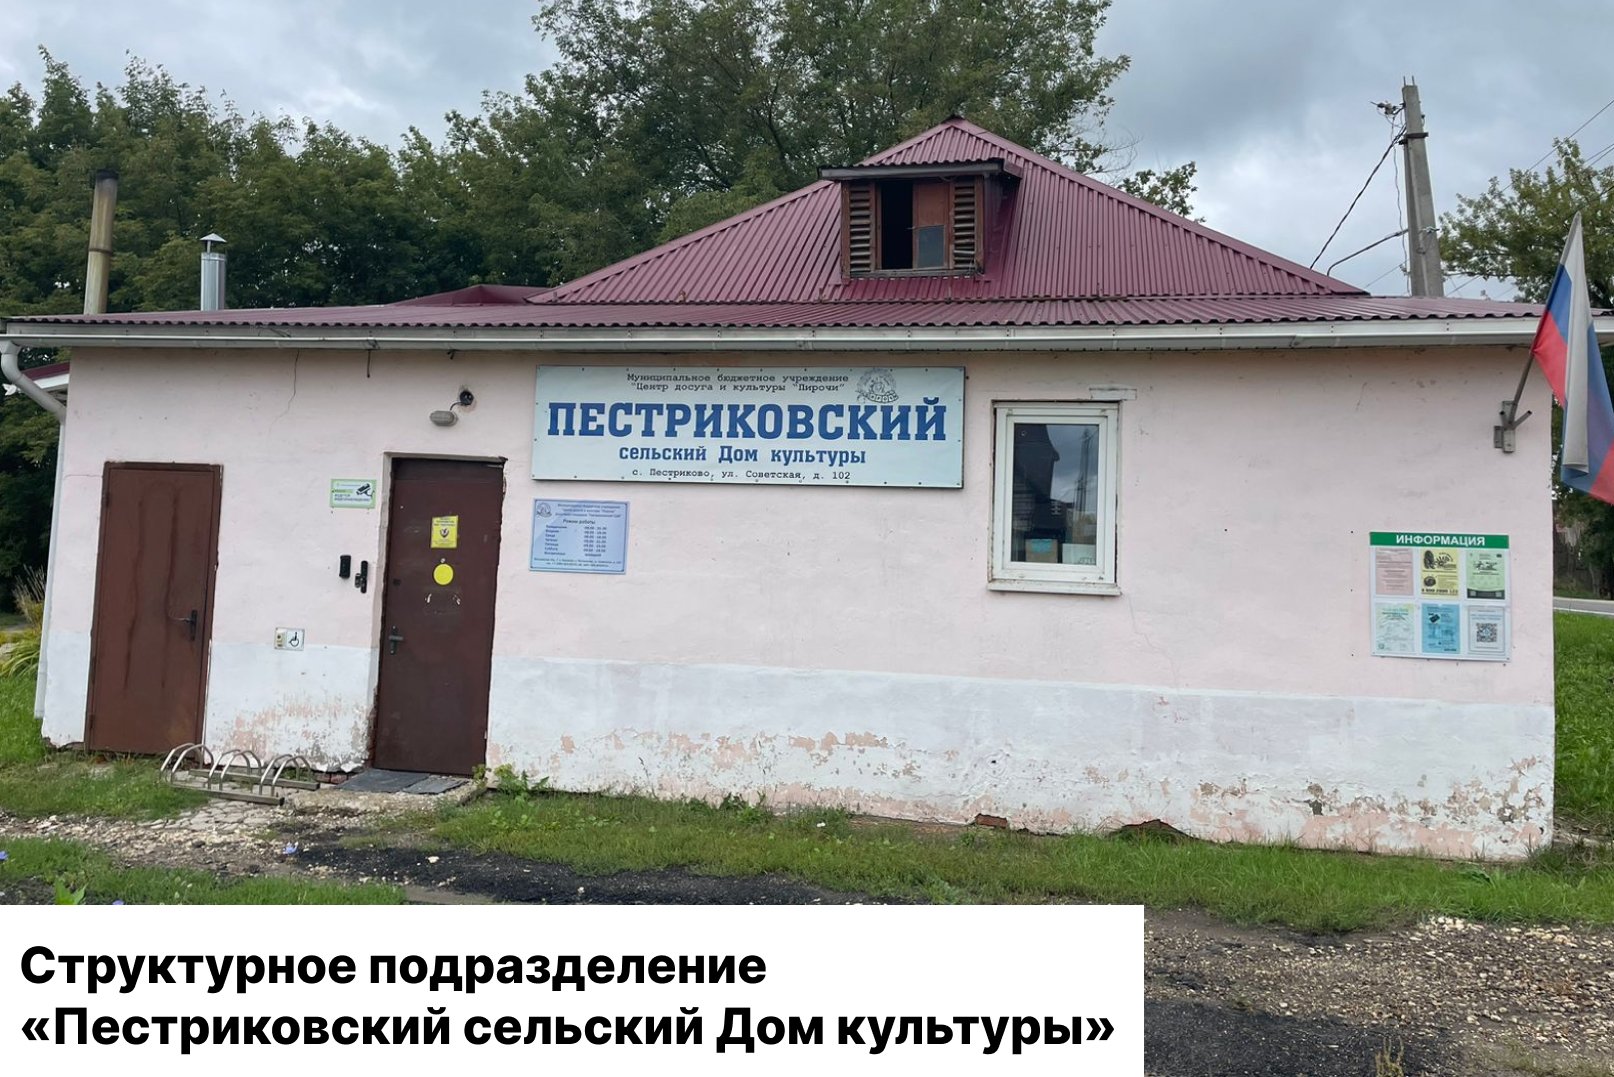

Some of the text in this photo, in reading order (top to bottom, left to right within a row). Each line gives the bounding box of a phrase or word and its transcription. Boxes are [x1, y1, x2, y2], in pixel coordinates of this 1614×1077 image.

[627, 373, 849, 384] Муниципальное бюджетное учреждение
[733, 384, 786, 393] культуры
[548, 397, 947, 441] ПЕСТРИКОВСКИЙ
[620, 445, 866, 467] сельский Дом культуры
[649, 468, 714, 479] Пестриково,
[745, 470, 806, 480] Советская,
[812, 472, 824, 480] д.
[832, 471, 851, 480] 102
[1395, 534, 1486, 547] ИНФОРМАЦИЯ
